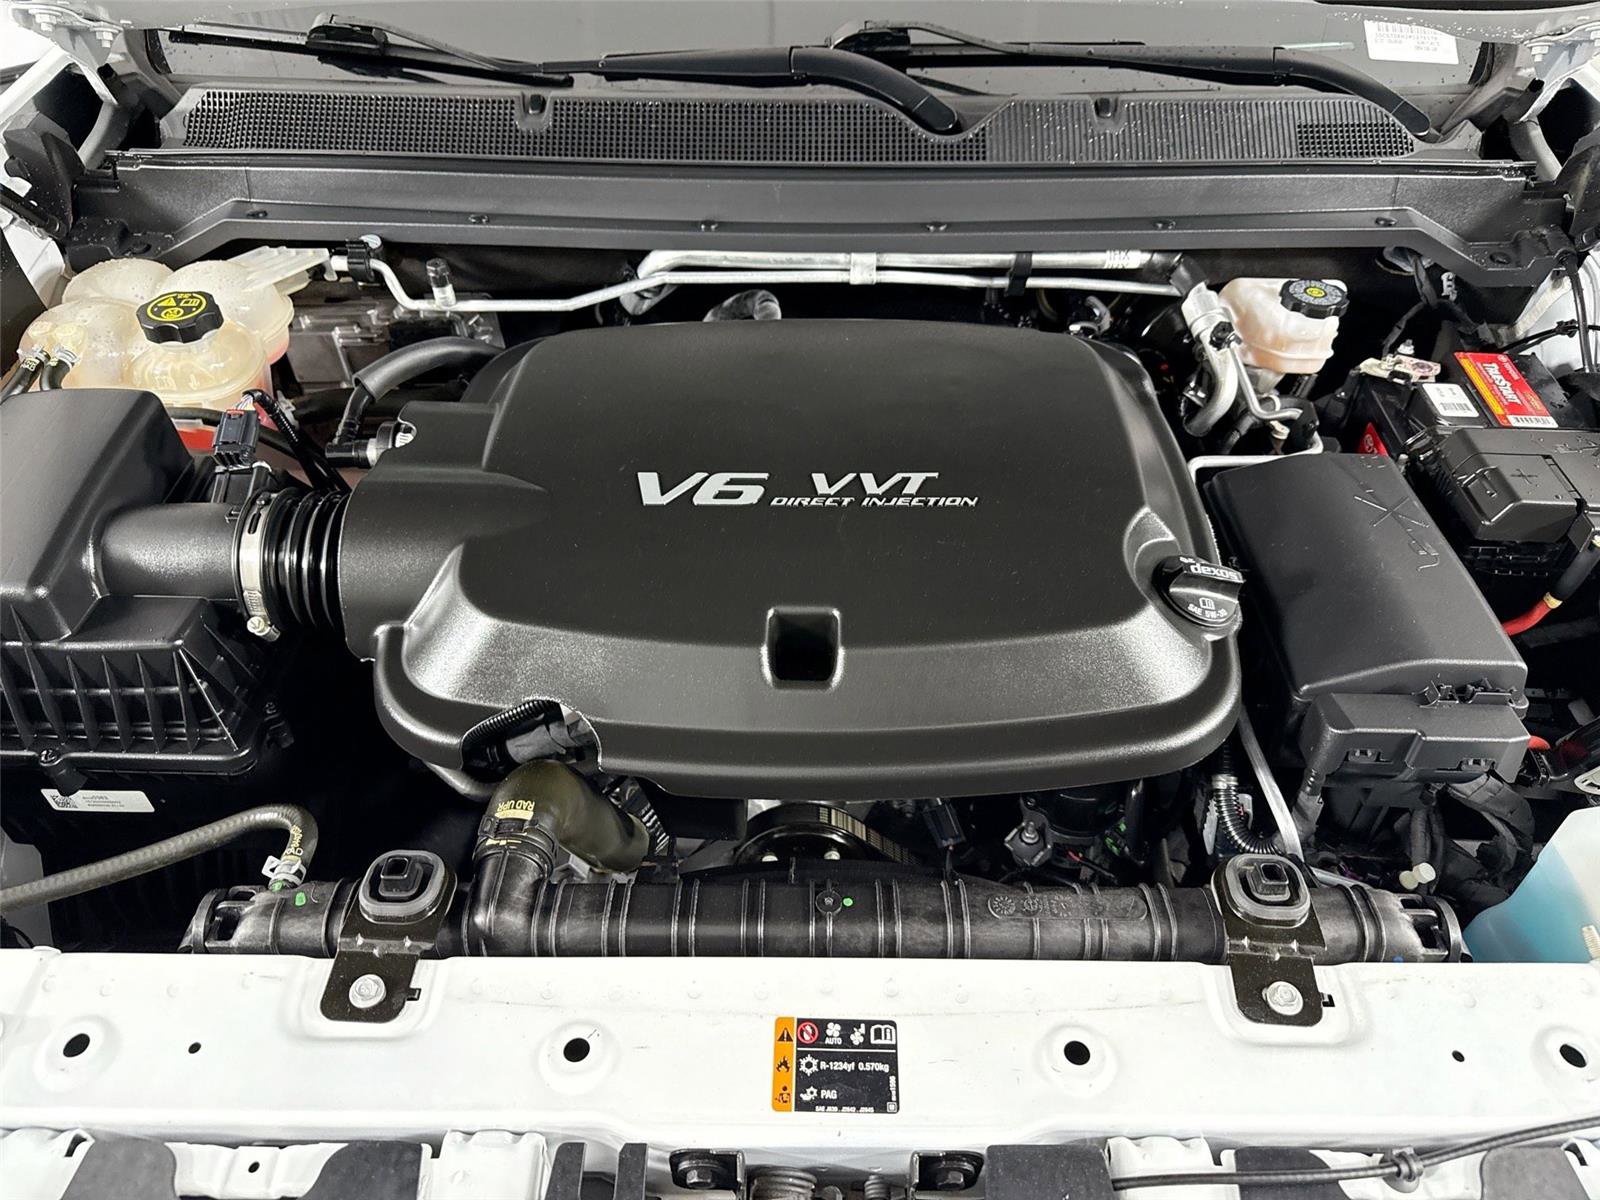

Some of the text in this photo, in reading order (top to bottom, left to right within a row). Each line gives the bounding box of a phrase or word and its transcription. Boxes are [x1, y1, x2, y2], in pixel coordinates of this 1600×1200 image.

[637, 472, 770, 506] V6
[811, 472, 939, 496] VVT
[769, 496, 979, 508] DIRECT INJECTION
[1190, 562, 1239, 580] dexos
[496, 799, 536, 812] RAD UPR
[824, 1037, 843, 1046] AUTO
[819, 1061, 890, 1073] R-1234yf 0.570kg
[820, 1089, 838, 1100] PAG
